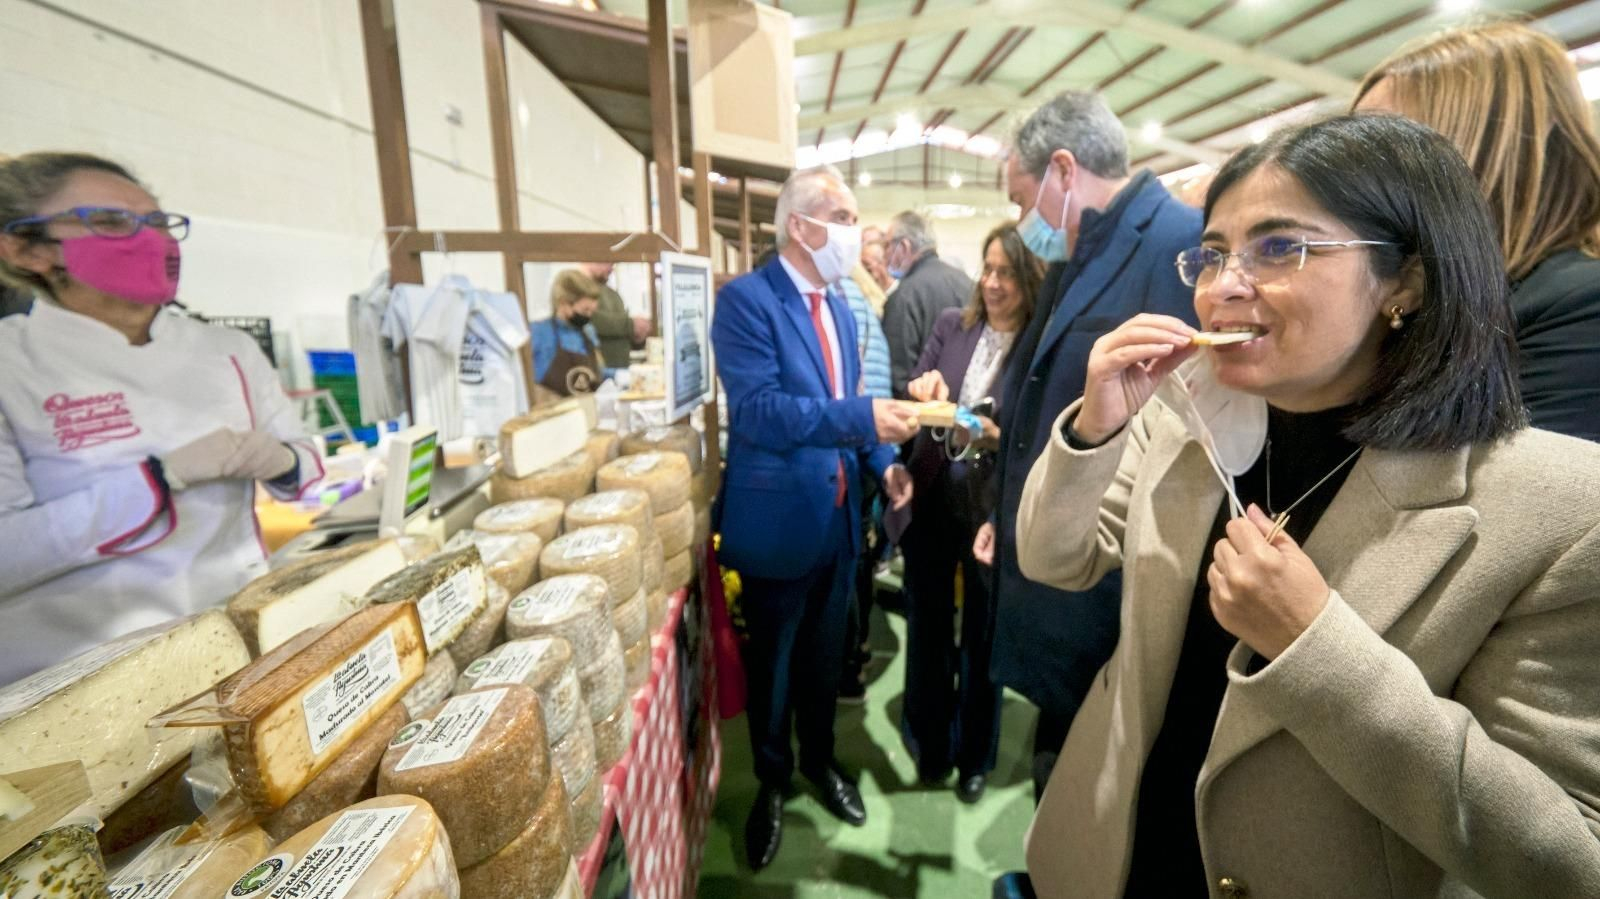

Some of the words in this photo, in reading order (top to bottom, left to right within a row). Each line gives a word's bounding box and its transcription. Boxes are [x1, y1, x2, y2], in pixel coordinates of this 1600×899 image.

[333, 663, 369, 698] Agustina
[341, 653, 366, 677] abuela
[319, 706, 356, 740] Madurado
[358, 698, 364, 707] al
[328, 702, 349, 721] Queso
[351, 693, 359, 702] de
[360, 675, 379, 693] Cabra
[271, 886, 285, 898] La
[286, 848, 323, 886] abuela
[282, 847, 344, 899] Agustina
[334, 865, 344, 875] de
[343, 840, 365, 864] Cabra
[336, 873, 347, 884] en
[344, 839, 376, 873] Manteca
